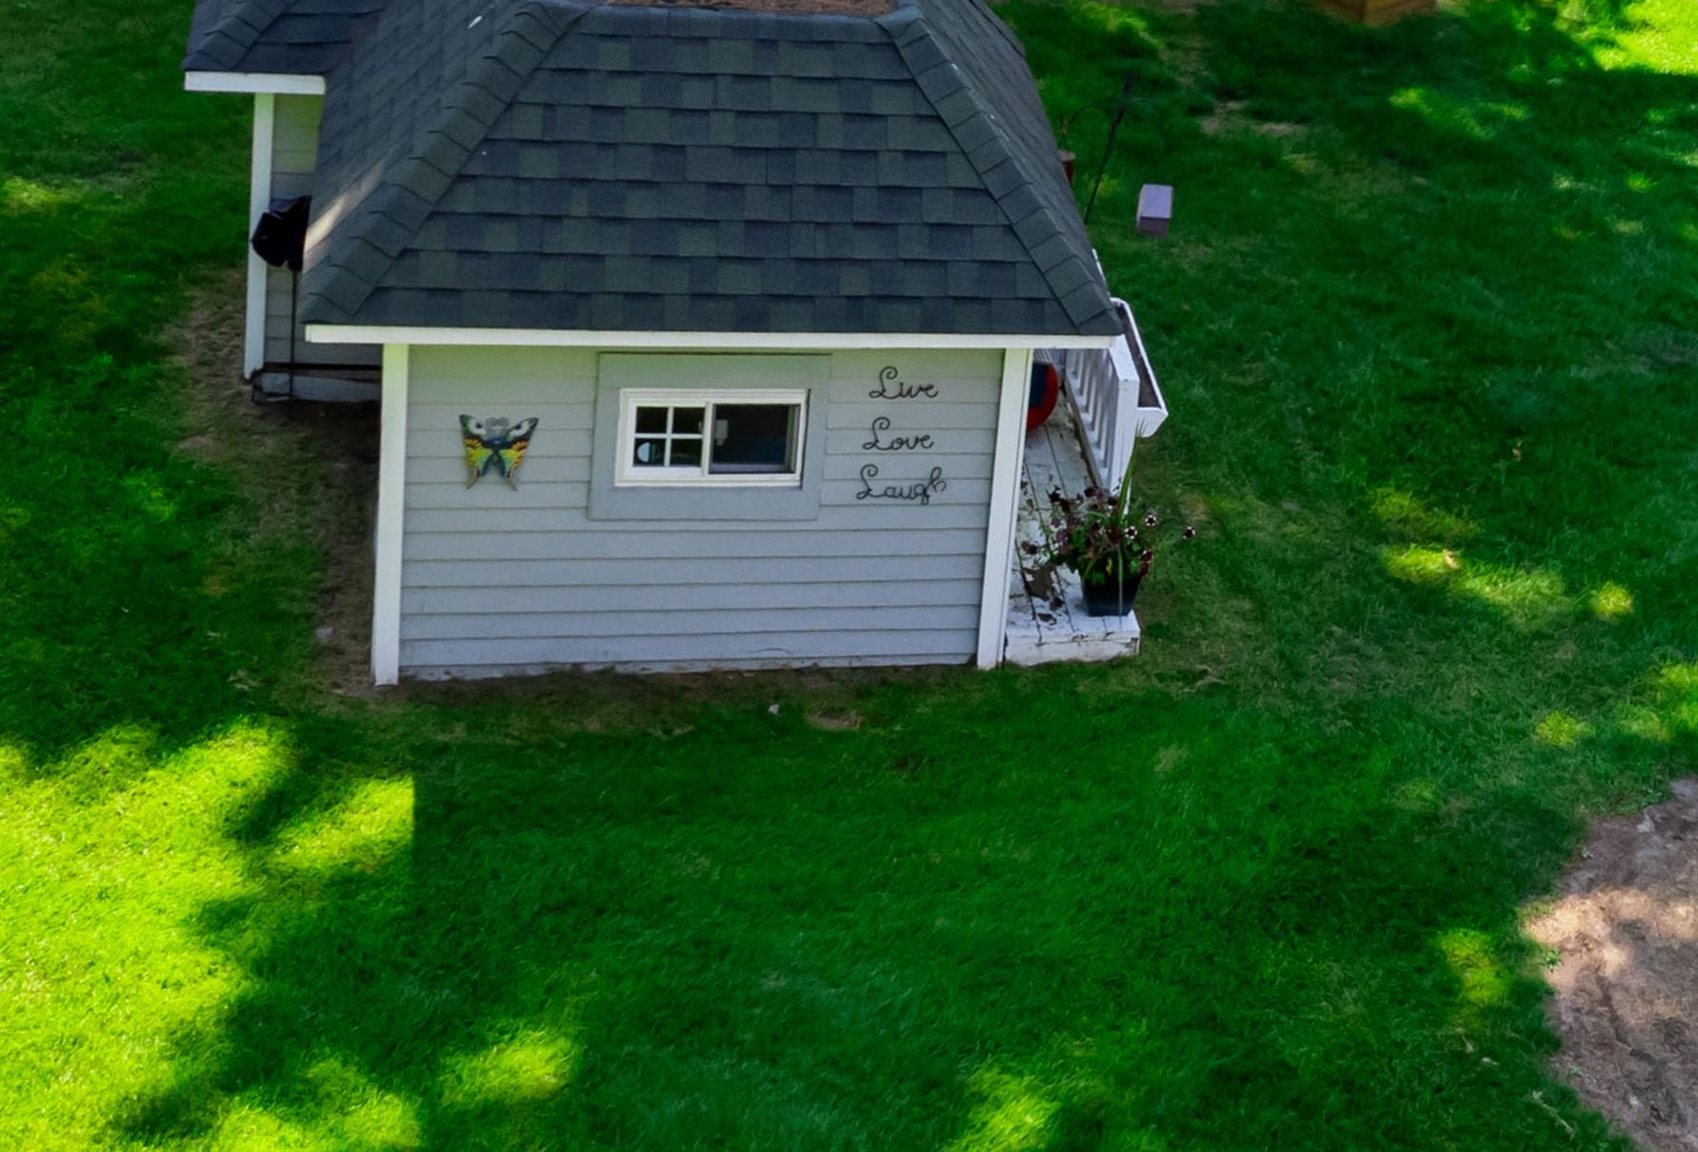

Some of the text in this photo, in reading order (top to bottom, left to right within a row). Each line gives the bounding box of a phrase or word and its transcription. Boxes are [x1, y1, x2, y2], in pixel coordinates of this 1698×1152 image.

[868, 365, 939, 399] Live
[862, 416, 935, 451] Love
[856, 463, 948, 506] Laugh
